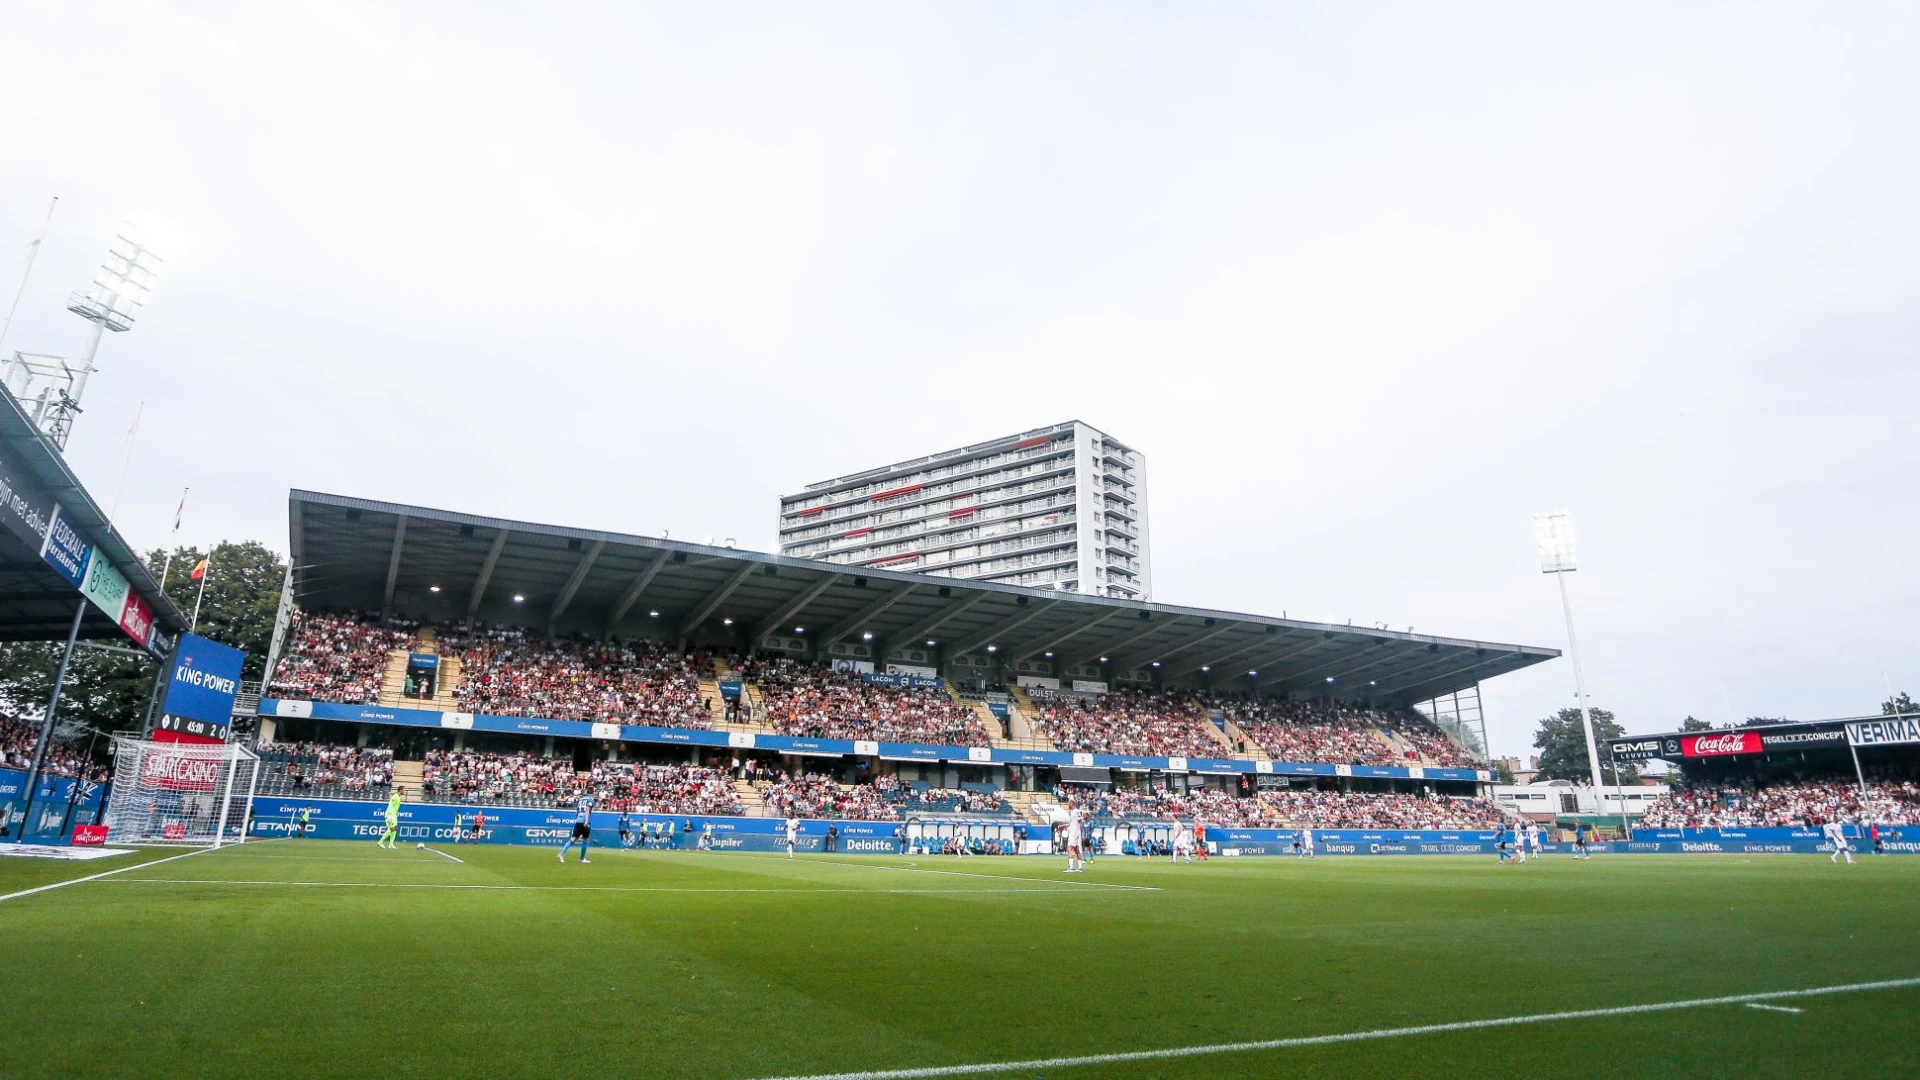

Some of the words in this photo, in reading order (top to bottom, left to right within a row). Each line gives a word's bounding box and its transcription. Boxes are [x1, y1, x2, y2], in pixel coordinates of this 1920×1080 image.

[10, 495, 29, 520] met
[25, 507, 49, 539] advies
[52, 518, 87, 562] FEDERALE
[175, 665, 202, 686] KING
[202, 672, 235, 695] POWER
[871, 675, 894, 683] LACOM
[1029, 689, 1054, 698] DULST
[173, 716, 180, 731] 0
[186, 721, 204, 734] 45:00
[209, 724, 216, 737] 2
[1847, 719, 1920, 744] VERIMA
[1694, 733, 1746, 754] Coca-Cola
[1761, 735, 1787, 745] TEGEL
[1807, 731, 1845, 741] CONCEPT
[1612, 740, 1659, 753] GMS
[1620, 751, 1654, 759] LEUVEN
[145, 746, 219, 783] STARCASINO
[256, 821, 317, 833] STANNO
[353, 824, 387, 836] TEGE
[525, 828, 570, 837] GMS
[711, 836, 743, 849] Jupiler
[847, 839, 895, 851] Deloitte.
[1420, 844, 1439, 852] TEGEL
[1456, 844, 1482, 852] CONCEPT
[1682, 842, 1722, 851] Deloitte.
[1326, 843, 1355, 855] banqup
